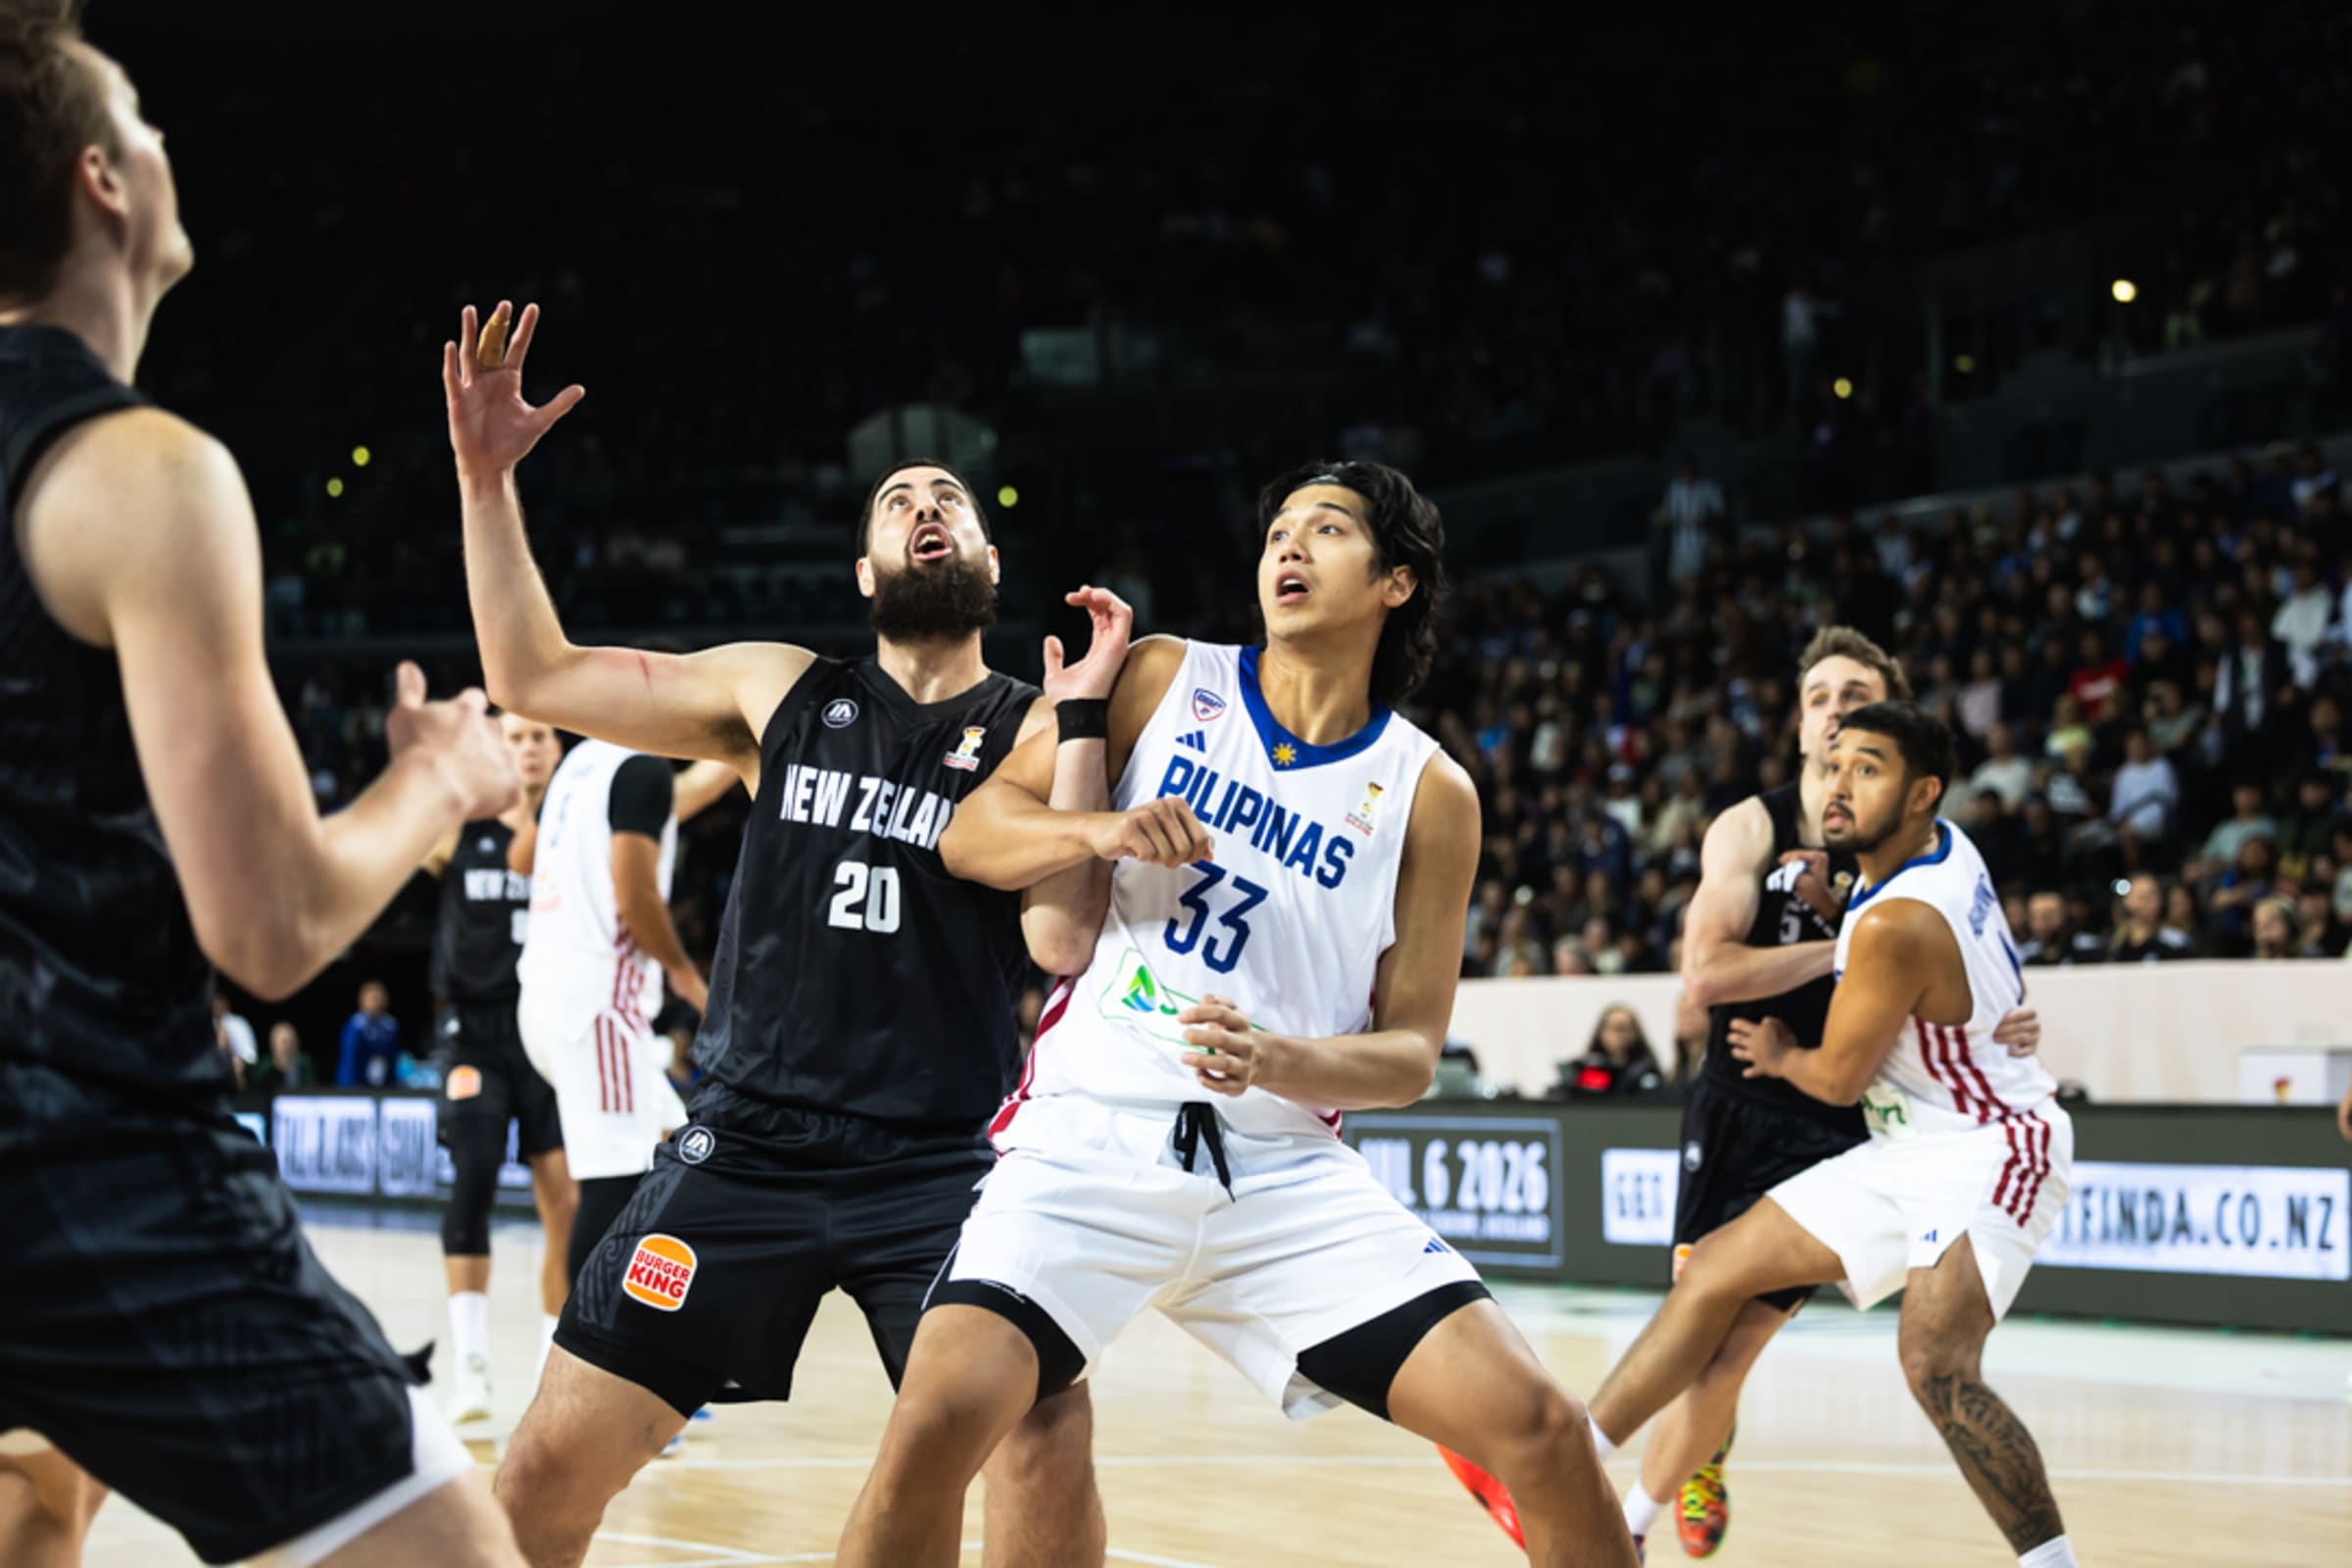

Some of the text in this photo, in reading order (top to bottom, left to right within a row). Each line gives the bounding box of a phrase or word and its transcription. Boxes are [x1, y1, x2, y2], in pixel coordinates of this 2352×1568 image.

[780, 763, 852, 827] NEW
[1156, 754, 1355, 890] PILIPINAS
[828, 859, 901, 933] 20
[1163, 859, 1269, 974] 33
[1424, 1139, 1449, 1210] 6
[1456, 1140, 1548, 1214] 2026
[628, 1262, 686, 1299] KING
[634, 1249, 691, 1282] BURGER
